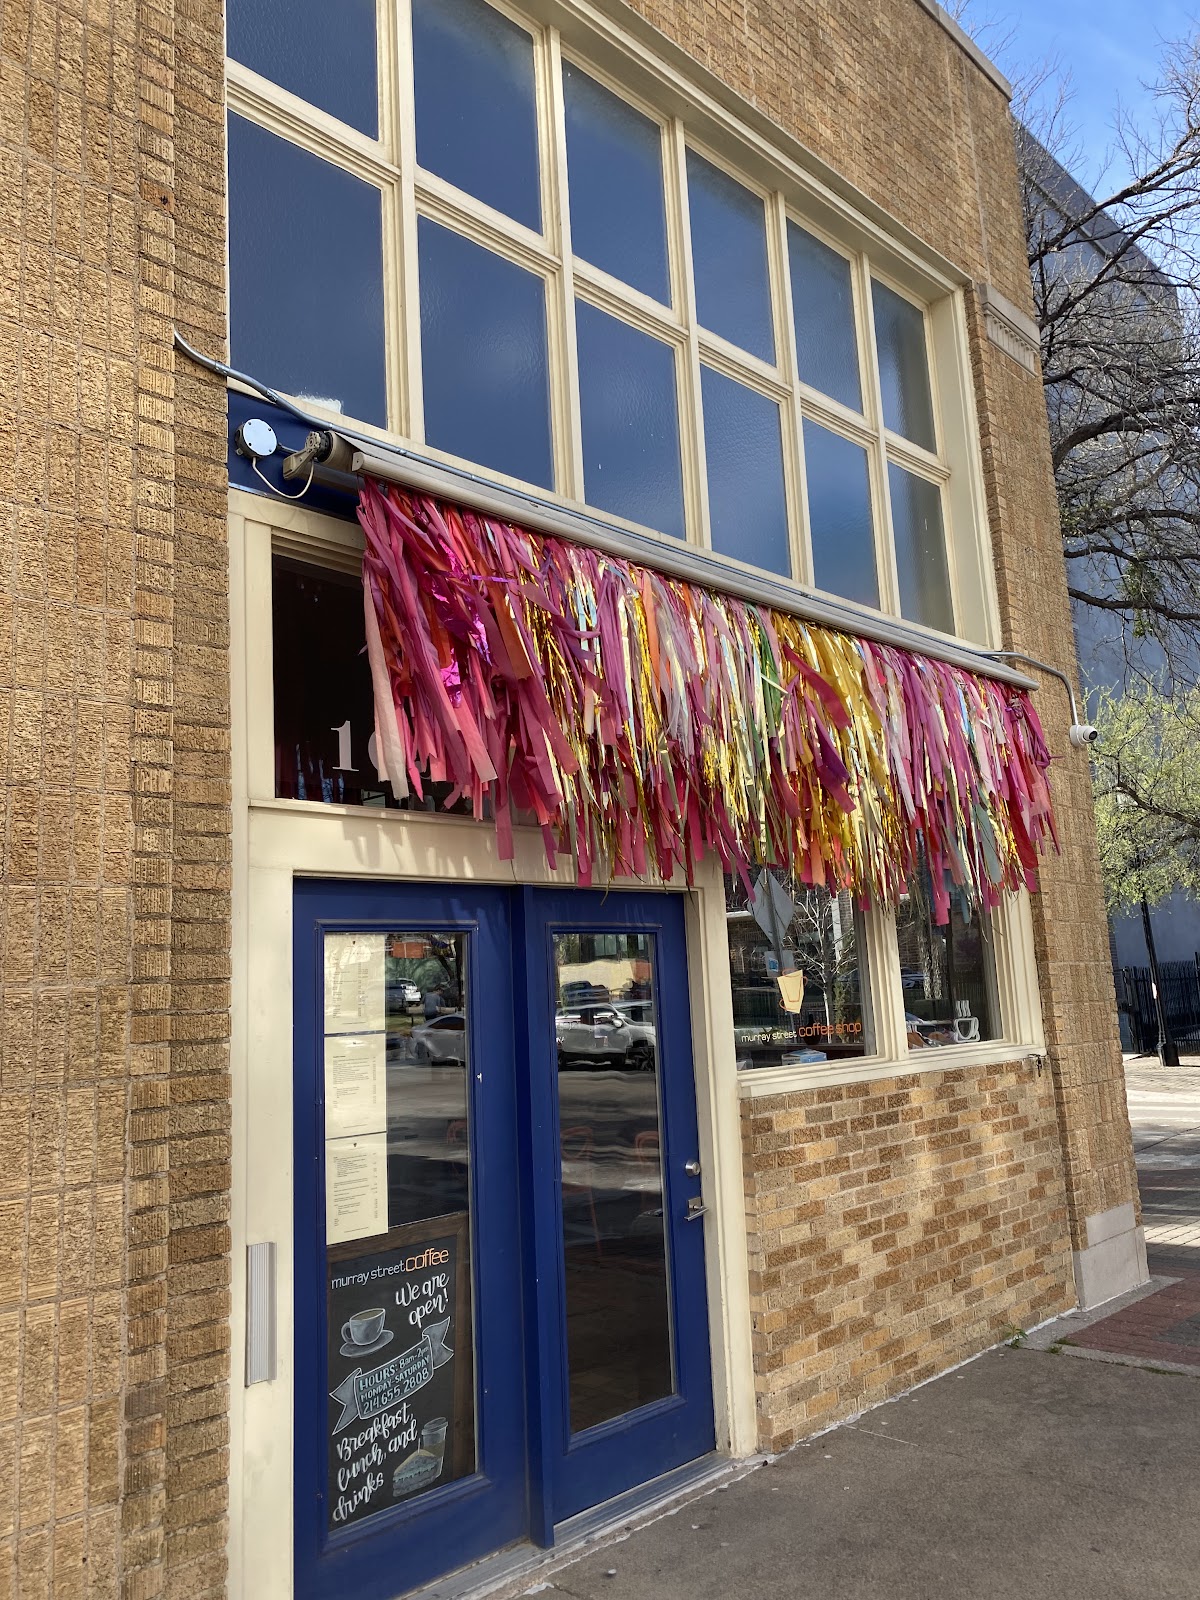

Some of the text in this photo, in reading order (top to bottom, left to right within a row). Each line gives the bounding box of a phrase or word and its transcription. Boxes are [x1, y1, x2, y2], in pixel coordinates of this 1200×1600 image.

[742, 1022, 861, 1042] murray street coffee shop
[331, 1248, 449, 1289] murray street coffee
[395, 1272, 450, 1307] We are
[409, 1288, 449, 1328] open!
[359, 1364, 398, 1391] HOURS:
[363, 1368, 429, 1415] 214.655.2808
[388, 1418, 418, 1453] and
[332, 1472, 384, 1522] drinks
